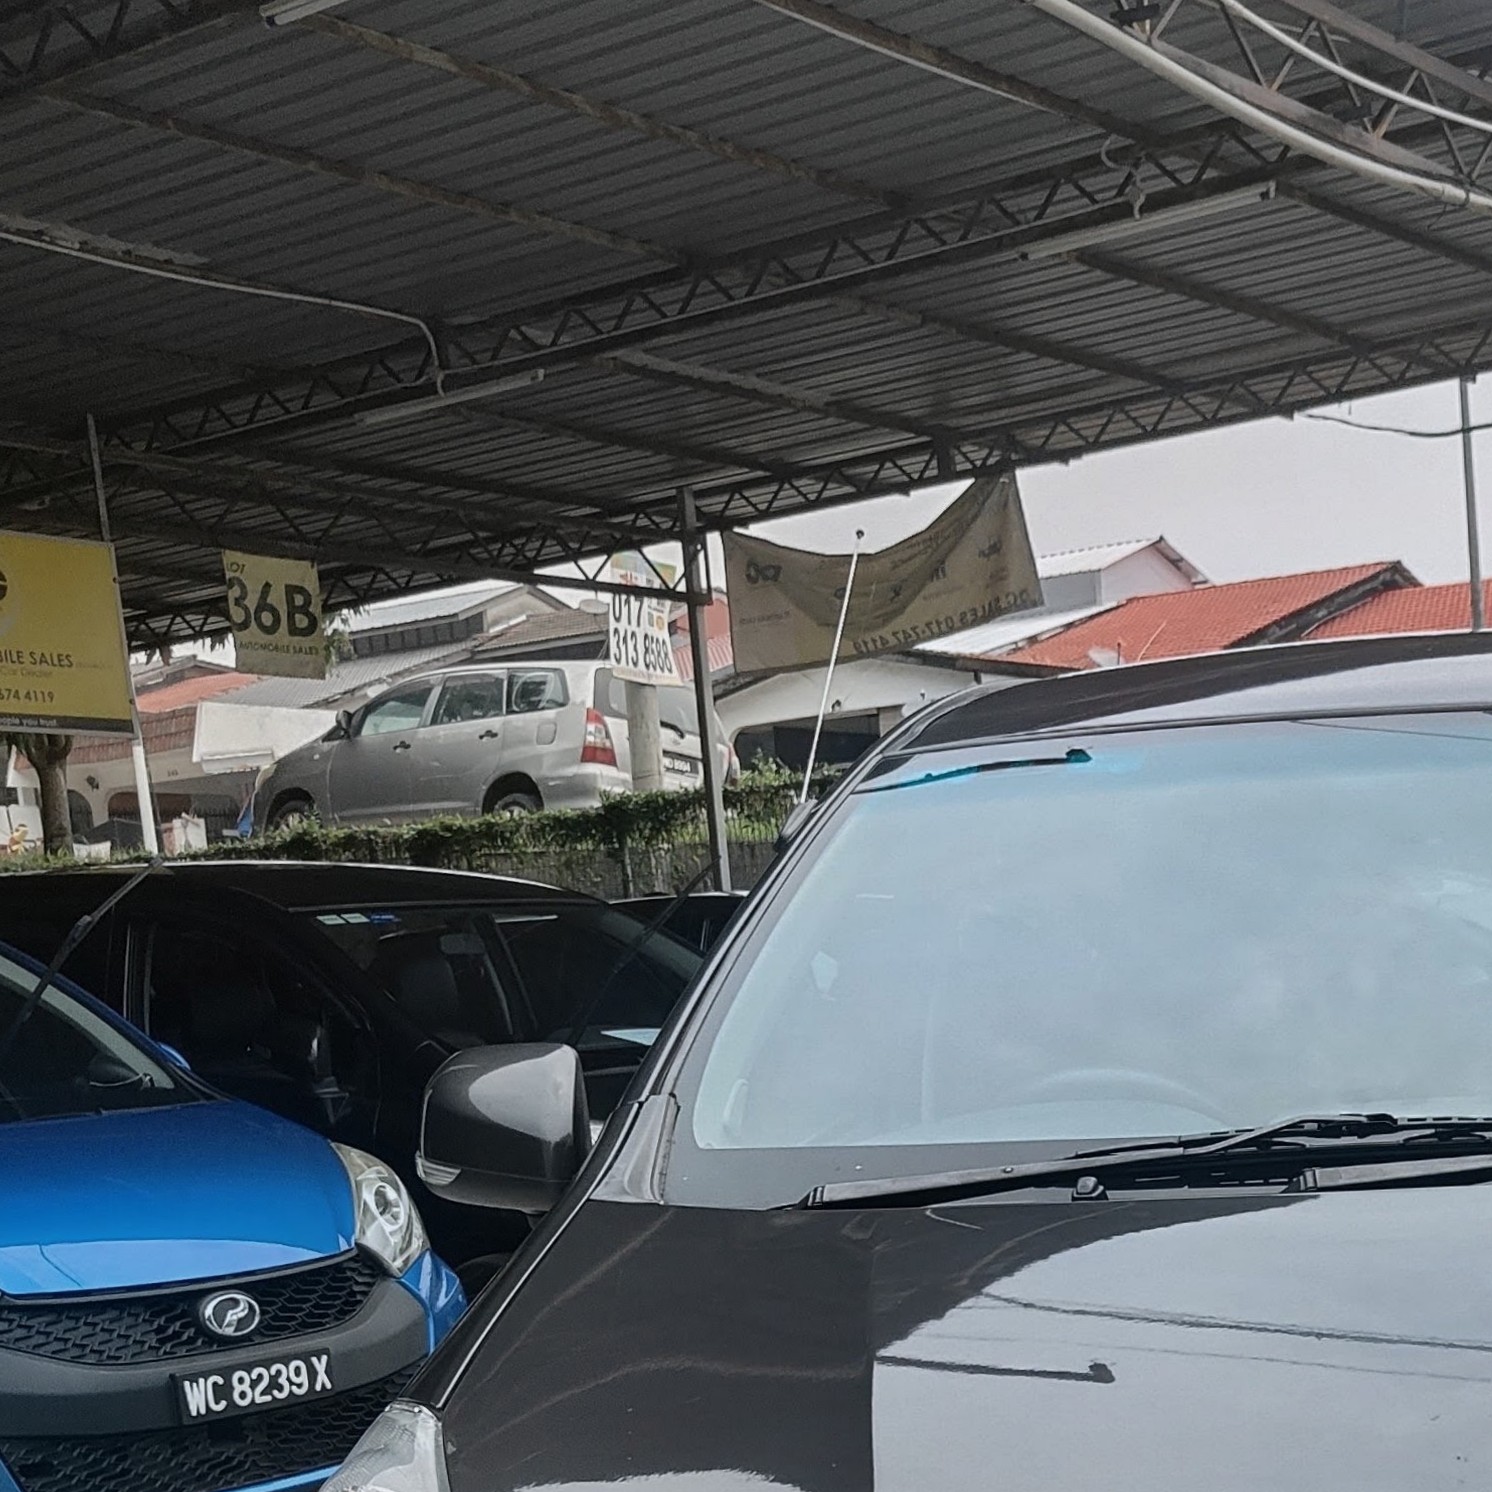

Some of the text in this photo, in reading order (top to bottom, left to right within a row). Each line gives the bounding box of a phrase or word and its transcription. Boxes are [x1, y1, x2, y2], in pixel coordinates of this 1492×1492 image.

[226, 575, 319, 637] 36B
[613, 592, 645, 628] 017
[29, 651, 74, 668] SALES
[613, 627, 673, 674] 313 8588
[24, 690, 55, 703] 4119
[183, 1374, 227, 1417] WC
[231, 1359, 309, 1407] 8239
